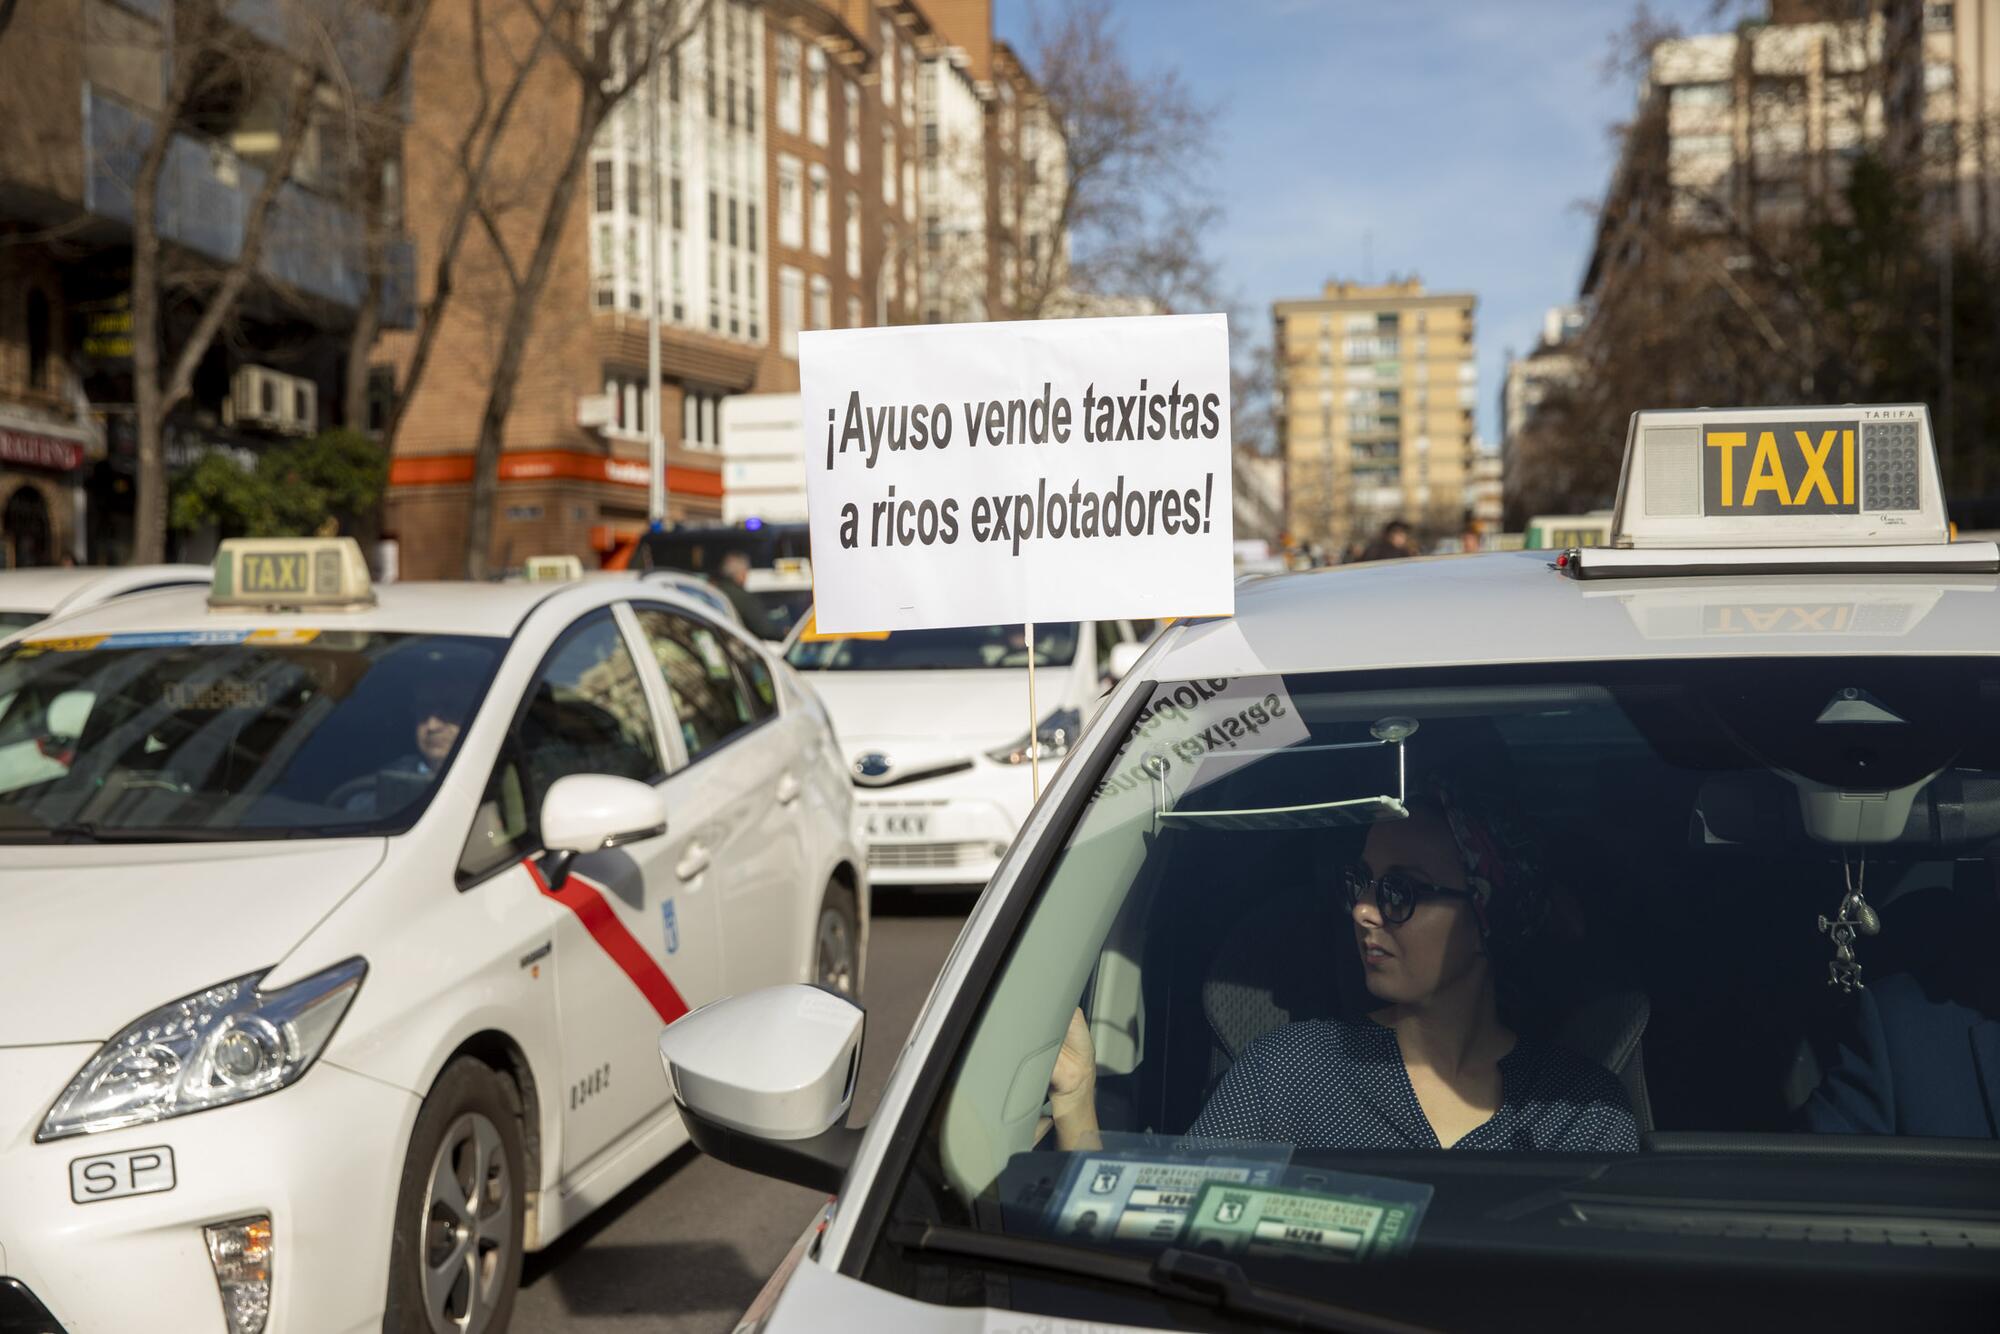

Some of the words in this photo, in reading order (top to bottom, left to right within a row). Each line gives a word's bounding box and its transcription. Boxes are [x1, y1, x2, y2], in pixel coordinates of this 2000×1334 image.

[826, 391, 952, 470] ¡Ayuso
[964, 382, 1072, 447] vende
[1083, 379, 1221, 444] taxistas
[1865, 411, 1915, 419] TARIFA
[1706, 430, 1855, 507] TAXI
[840, 502, 859, 549] a
[870, 485, 959, 548] ricos
[971, 473, 1214, 557] explotadores!
[245, 556, 306, 590] TAXI
[84, 1154, 161, 1193] SP
